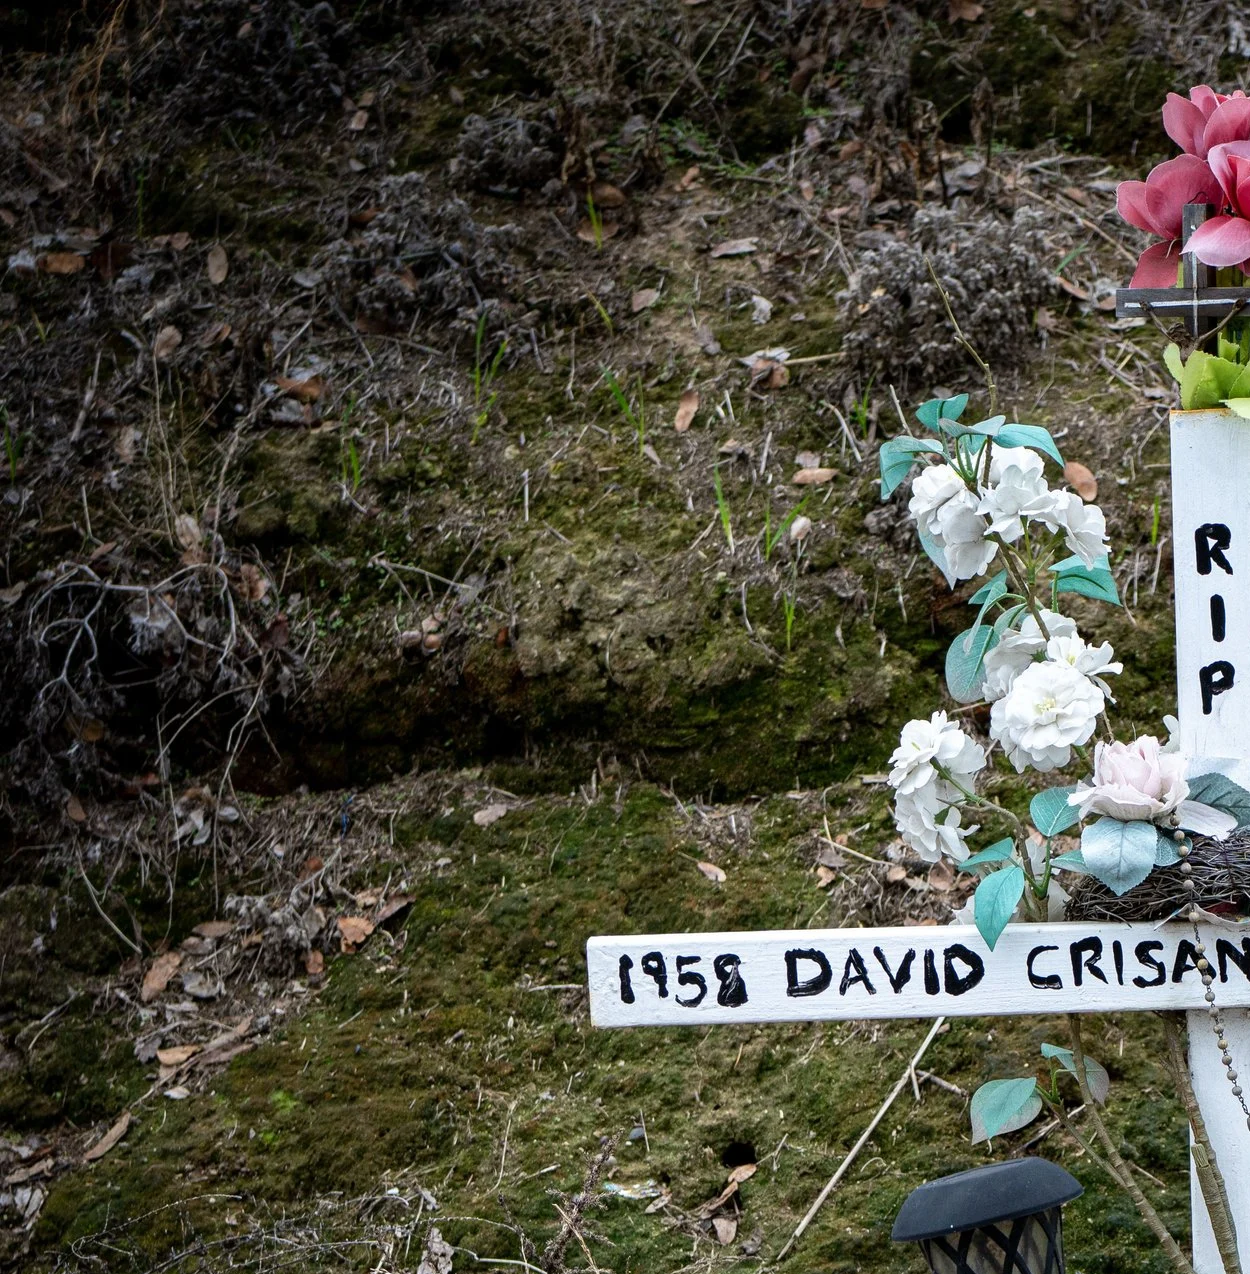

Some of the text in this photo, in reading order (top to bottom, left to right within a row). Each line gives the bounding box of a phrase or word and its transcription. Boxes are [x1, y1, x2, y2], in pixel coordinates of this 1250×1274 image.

[1195, 523, 1235, 715] RIP
[618, 951, 749, 1008] 1958
[784, 943, 985, 998] DAVID
